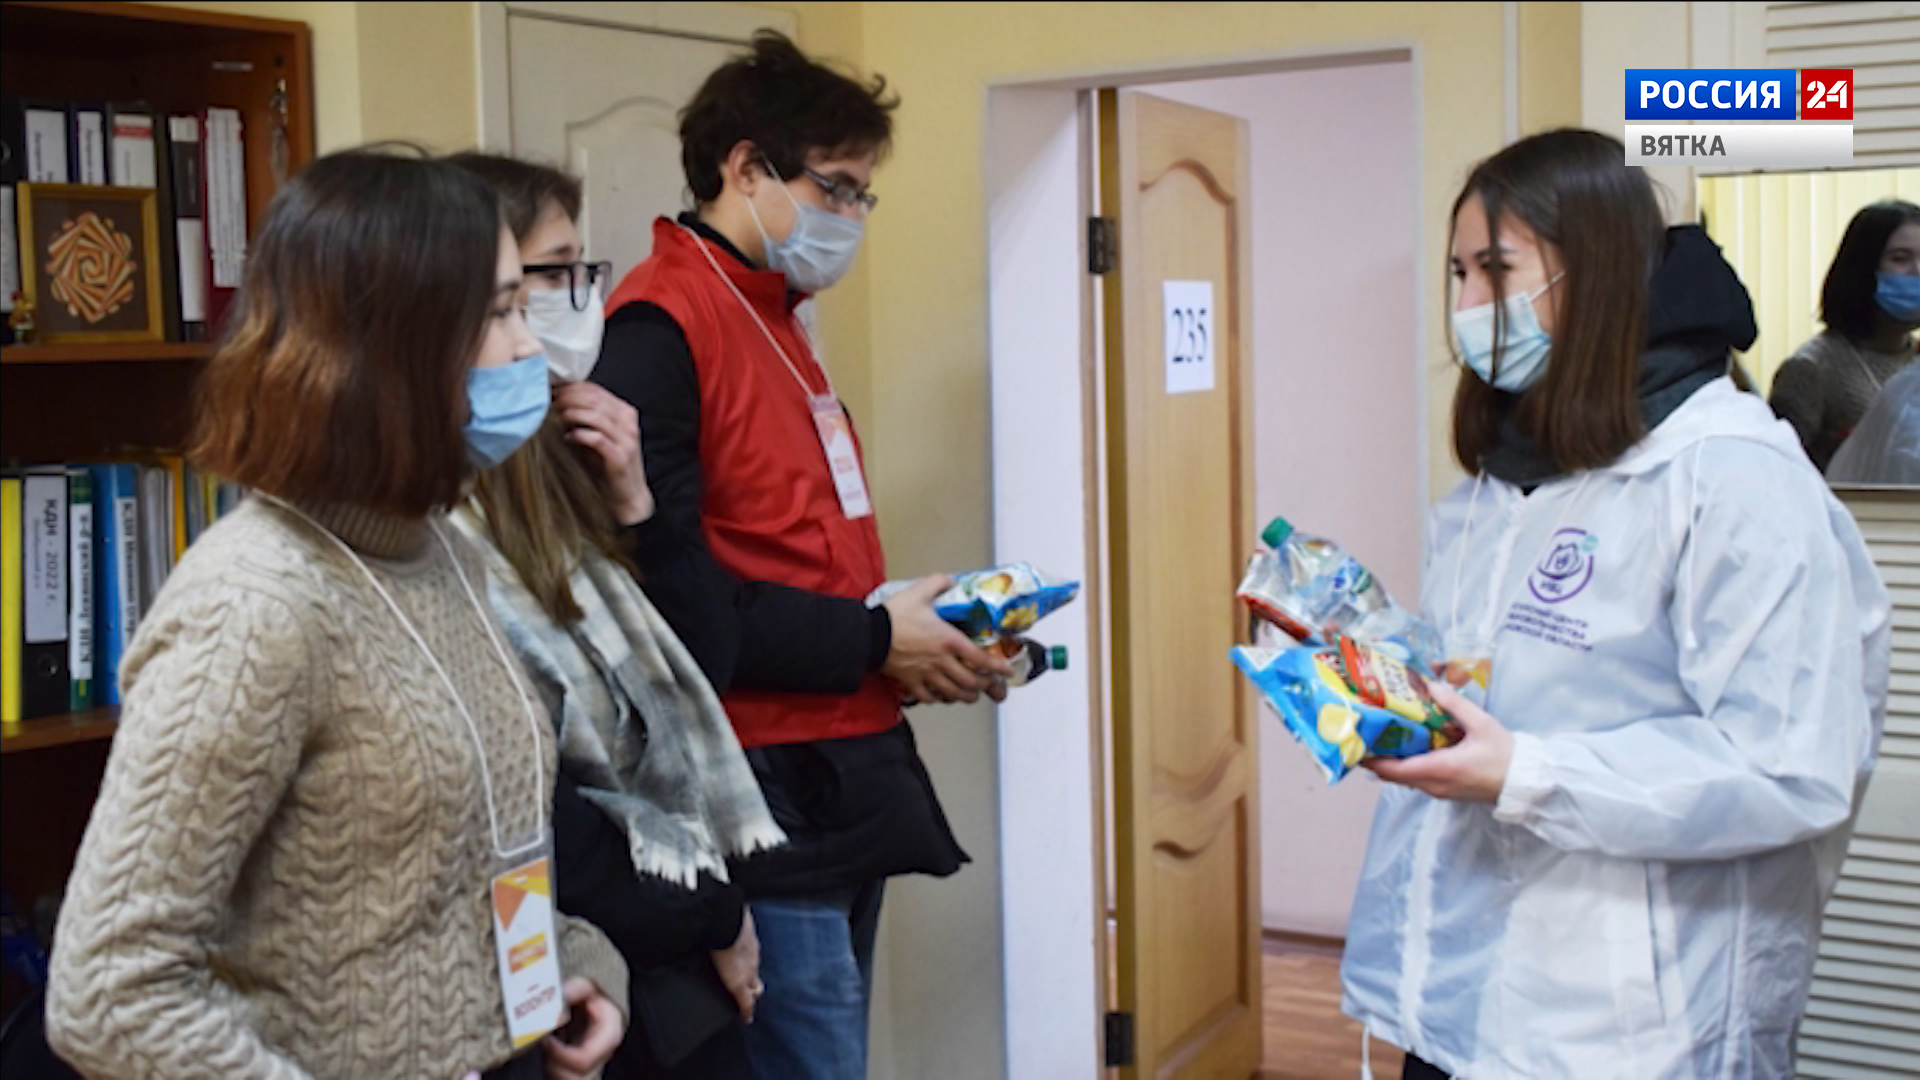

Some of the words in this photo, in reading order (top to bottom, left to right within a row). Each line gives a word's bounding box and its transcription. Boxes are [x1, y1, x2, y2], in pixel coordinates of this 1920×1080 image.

[1172, 307, 1207, 363] 235
[44, 499, 58, 536] КДН
[46, 551, 58, 590] 2022
